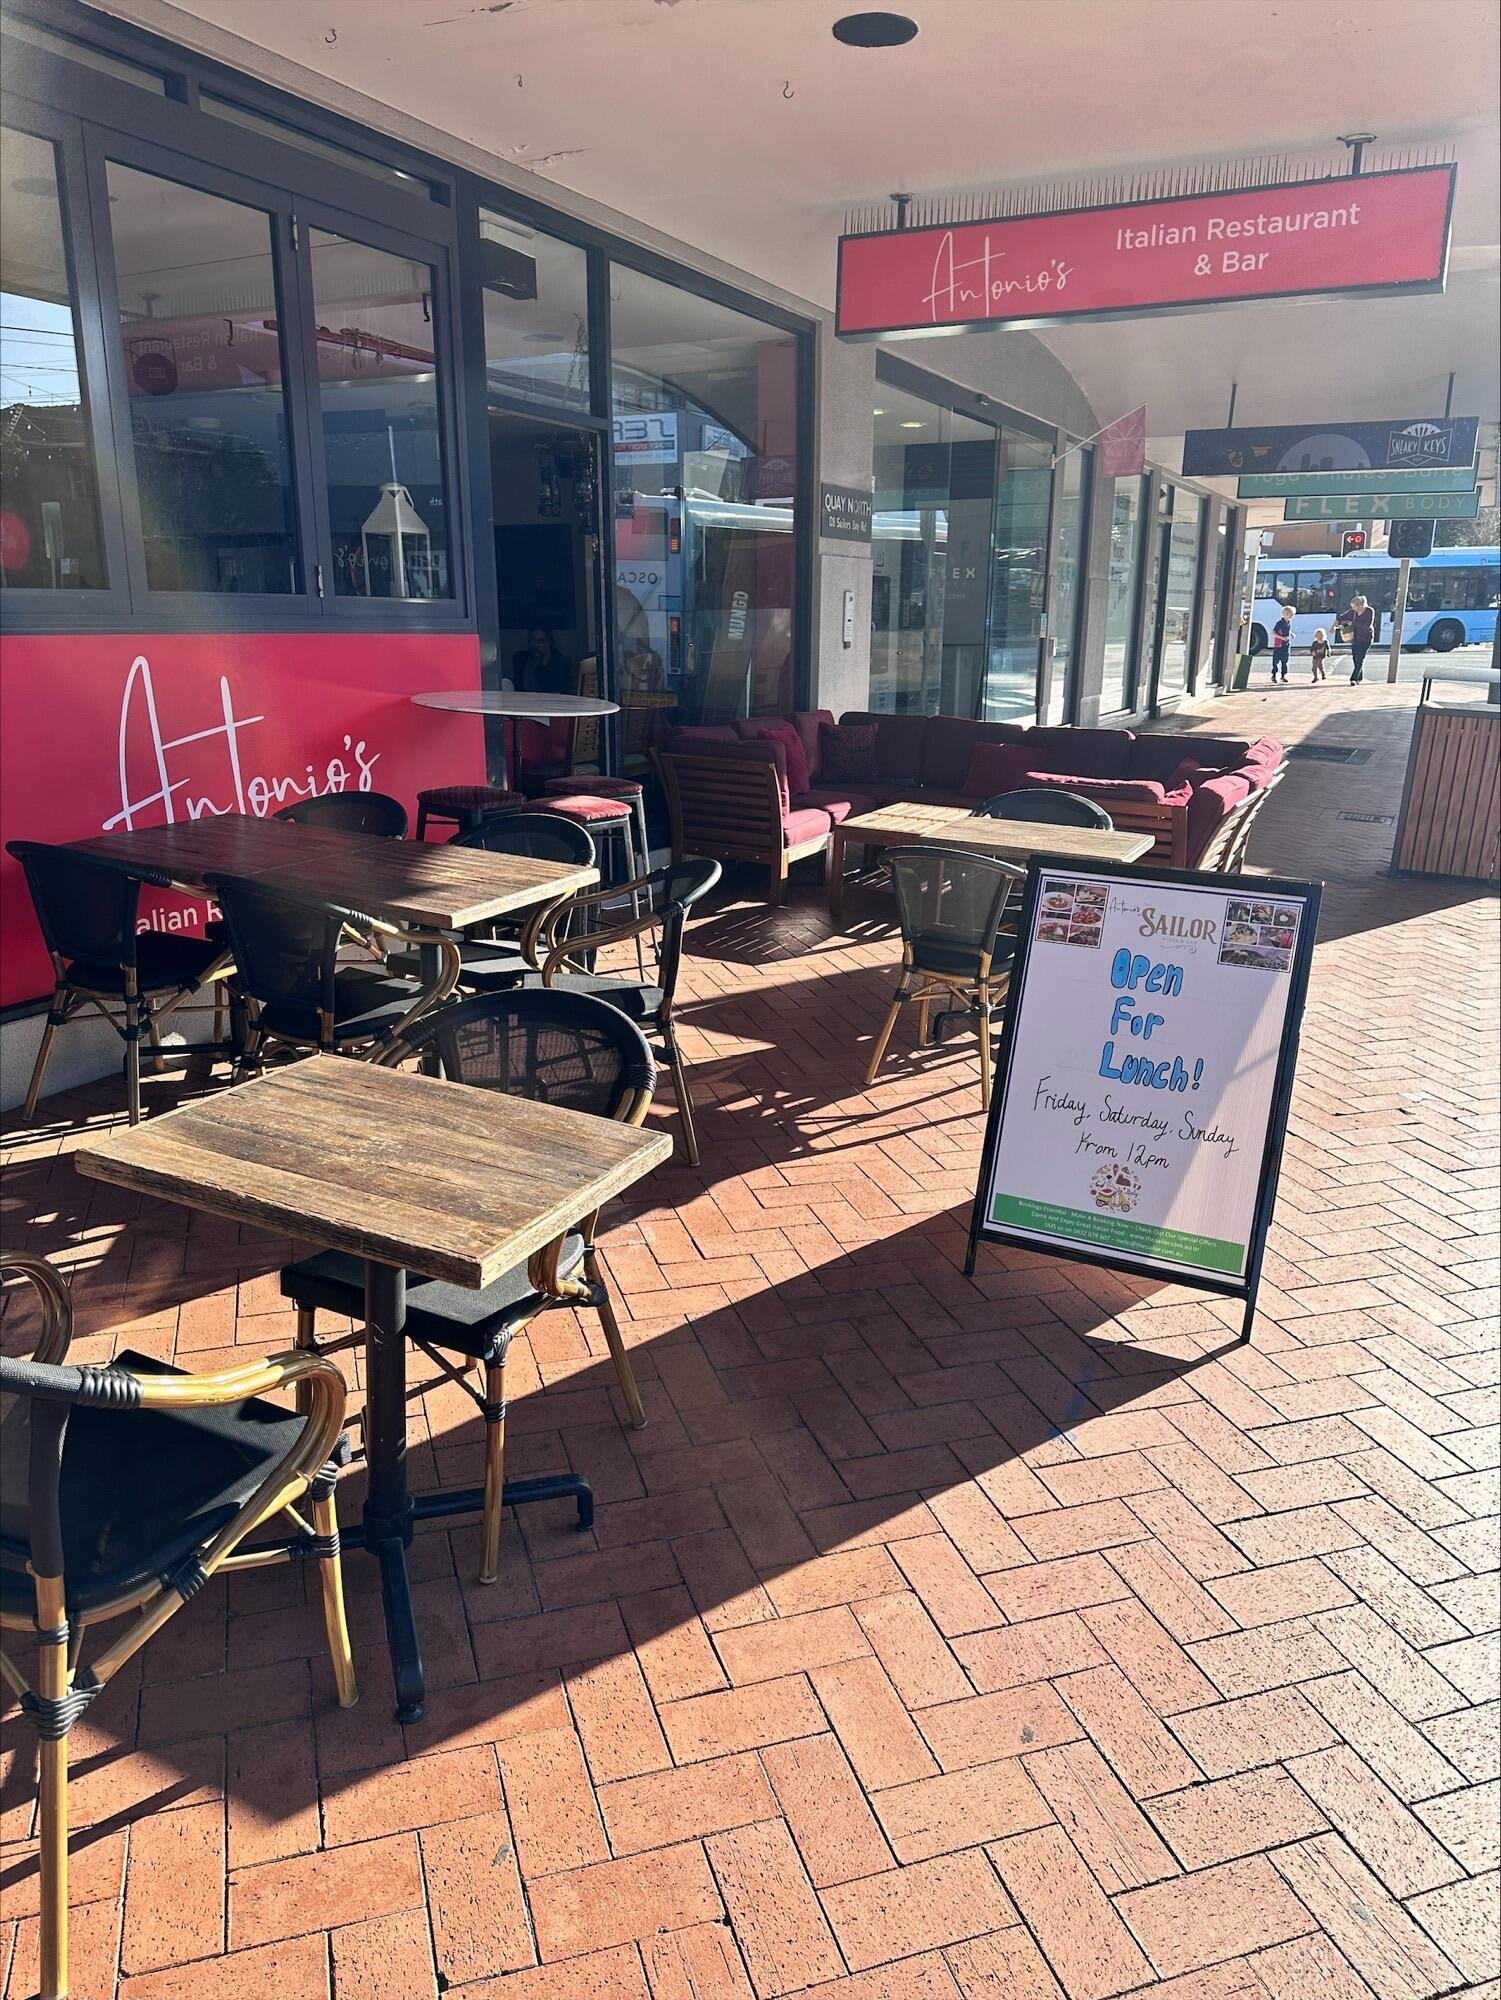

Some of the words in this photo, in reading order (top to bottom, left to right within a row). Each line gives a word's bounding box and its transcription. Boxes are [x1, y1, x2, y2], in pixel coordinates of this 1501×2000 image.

[1115, 223, 1197, 251] Italian
[1206, 202, 1361, 241] Restaurant
[922, 231, 1075, 322] Antonio's
[1193, 253, 1212, 275] &
[1222, 248, 1270, 274] Bar
[1390, 438, 1418, 457] SNEAKY
[1423, 436, 1447, 455] KEYS
[824, 493, 847, 513] QUAY
[847, 497, 872, 517] NORTH
[1296, 496, 1391, 515] FLEX
[1405, 496, 1465, 510] BODY
[727, 590, 749, 641] MUNGO
[102, 655, 381, 832] Antonio's
[135, 906, 198, 936] alian
[1138, 907, 1217, 945] SAILOR
[1110, 996, 1165, 1040] For
[1099, 1041, 1204, 1092] Lunch!
[1178, 1110, 1240, 1159] Sunday
[1126, 1142, 1170, 1169] 12pm
